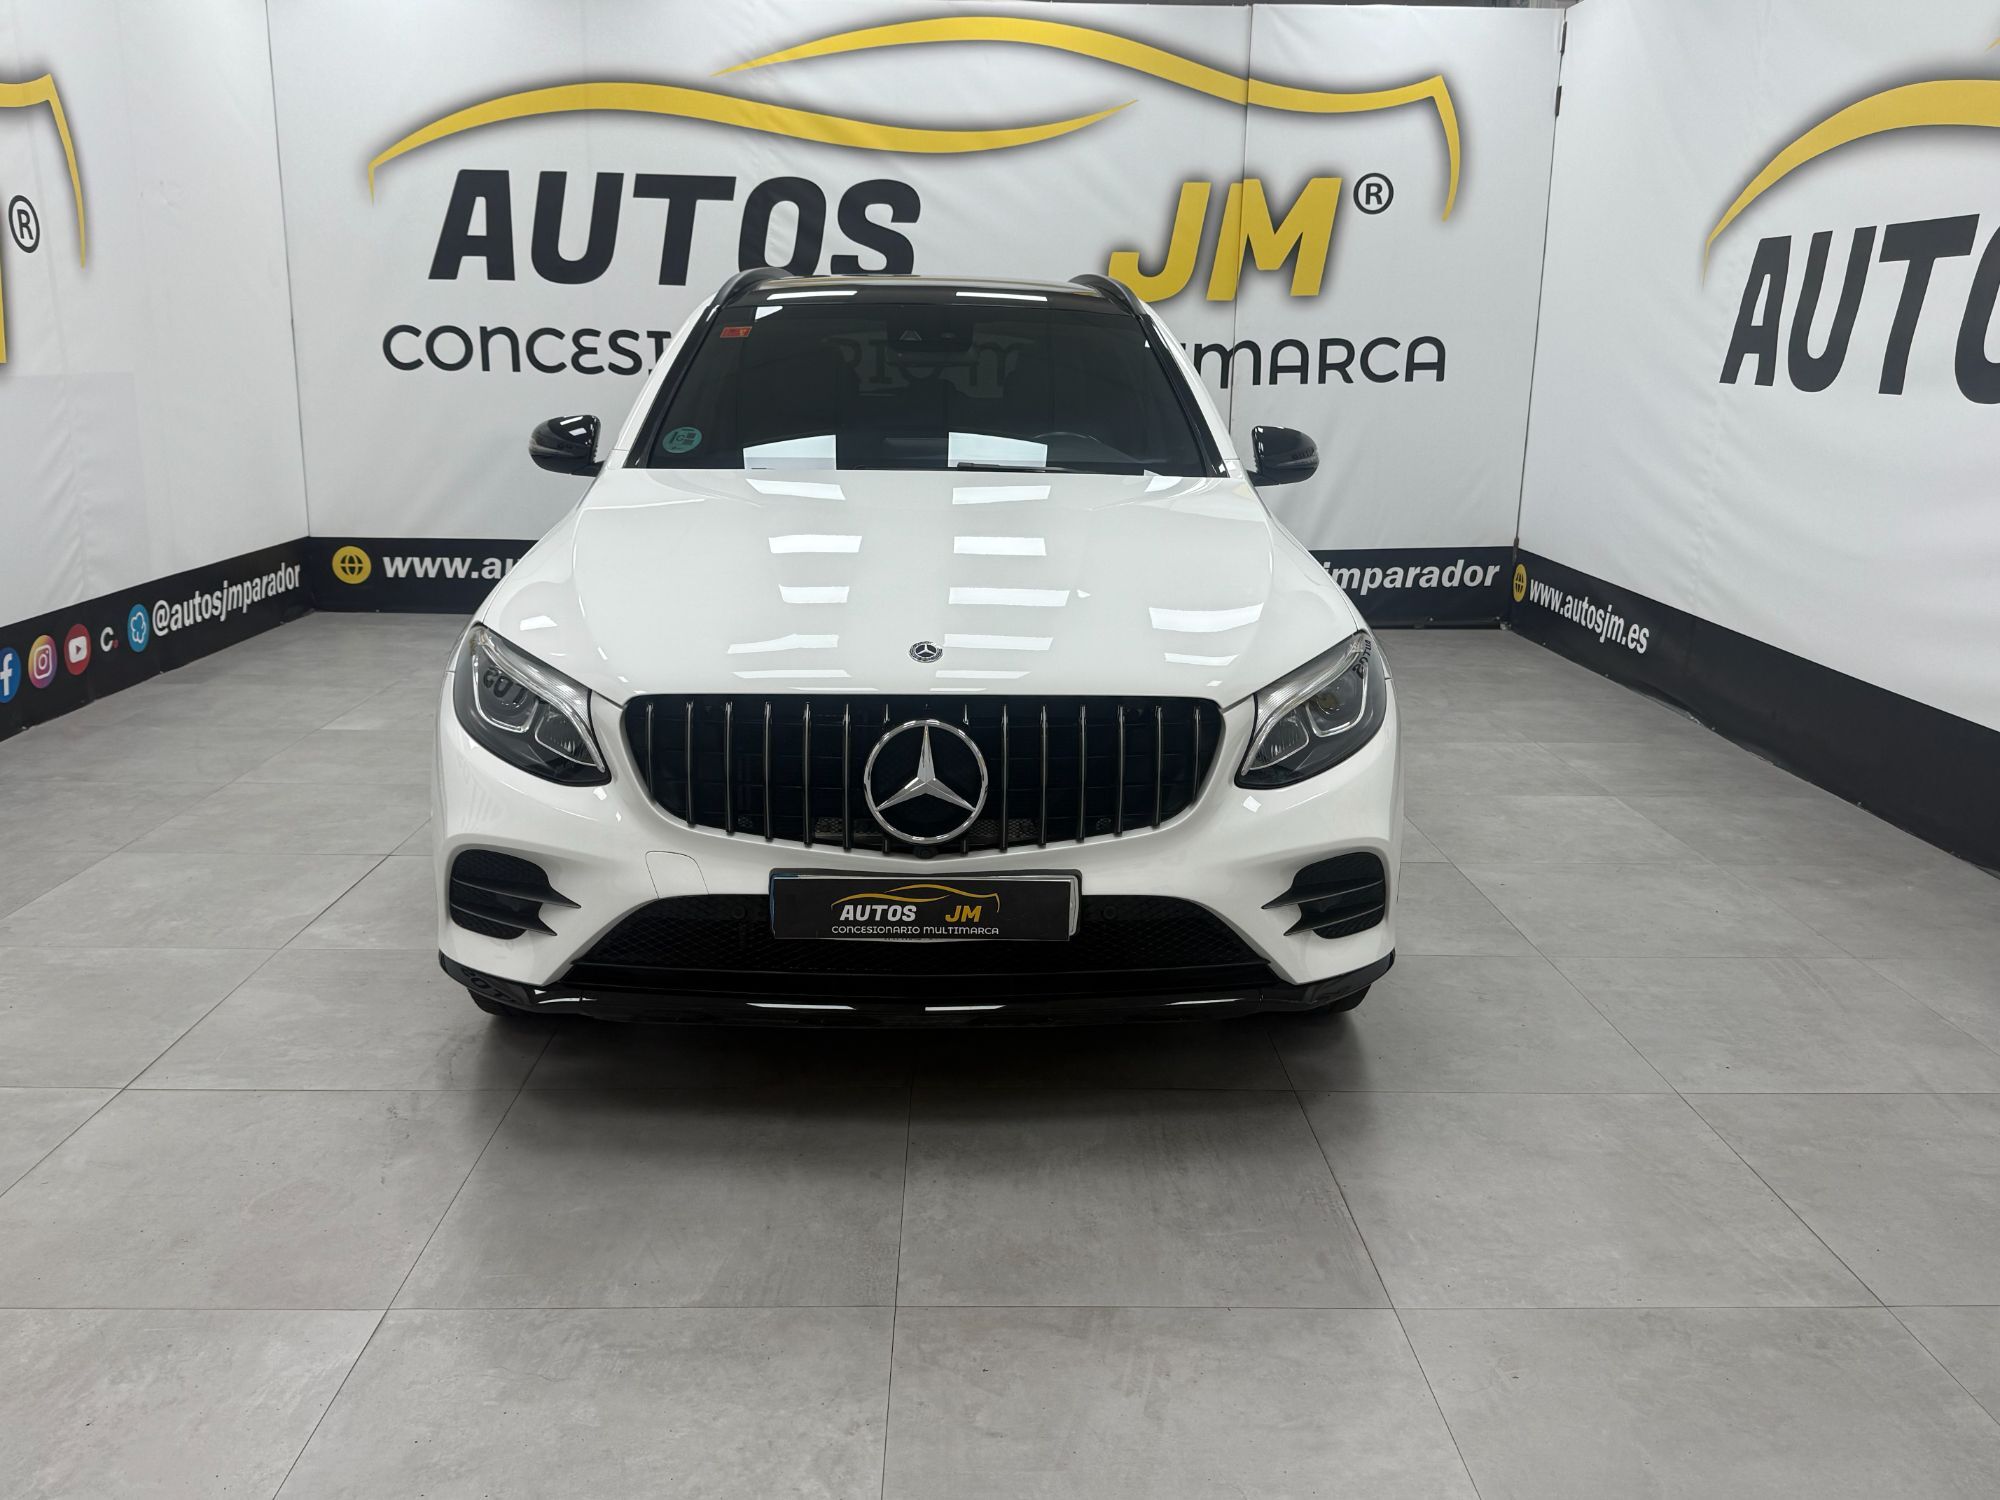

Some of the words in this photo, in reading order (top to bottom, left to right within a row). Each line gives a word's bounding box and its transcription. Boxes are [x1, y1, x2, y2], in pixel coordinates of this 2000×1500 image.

[428, 169, 921, 287] AUTOS
[1108, 177, 1343, 302] JM
[1179, 335, 1447, 390] MARCA
[151, 561, 301, 637] @autosjmparador
[1529, 578, 1650, 654] www.autosjm.es
[831, 925, 921, 935] CONCESIONARIO
[923, 926, 999, 935] MULTIMARCA
[839, 904, 917, 922] AUTOS
[944, 905, 982, 923] JM
